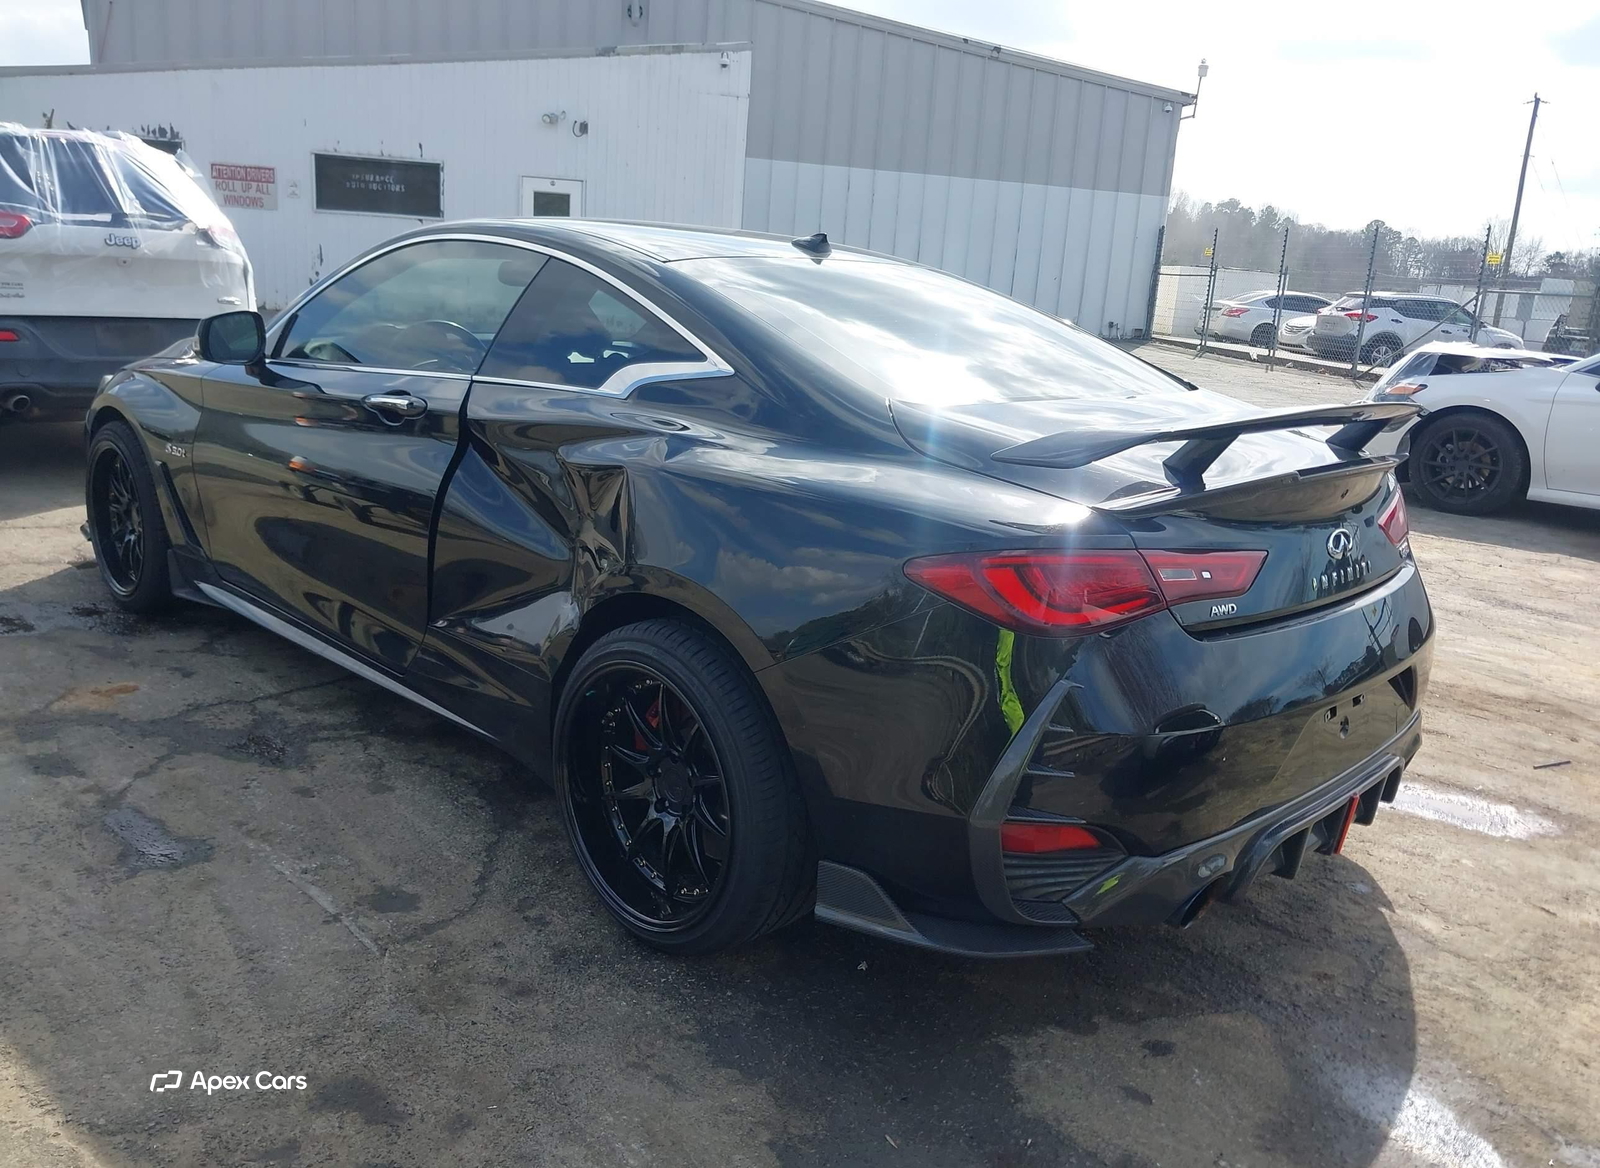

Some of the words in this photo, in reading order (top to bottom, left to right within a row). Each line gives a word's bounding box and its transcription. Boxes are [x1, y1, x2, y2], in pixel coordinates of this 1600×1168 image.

[212, 165, 246, 180] ATTENTION
[246, 167, 274, 182] DRIVERS
[215, 180, 237, 193] ROLL
[241, 182, 253, 193] UP
[255, 183, 271, 195] ALL
[223, 194, 264, 208] WINDOWS
[104, 233, 141, 249] Jeep
[1312, 559, 1372, 592] INFINITI
[1209, 603, 1238, 618] AWD
